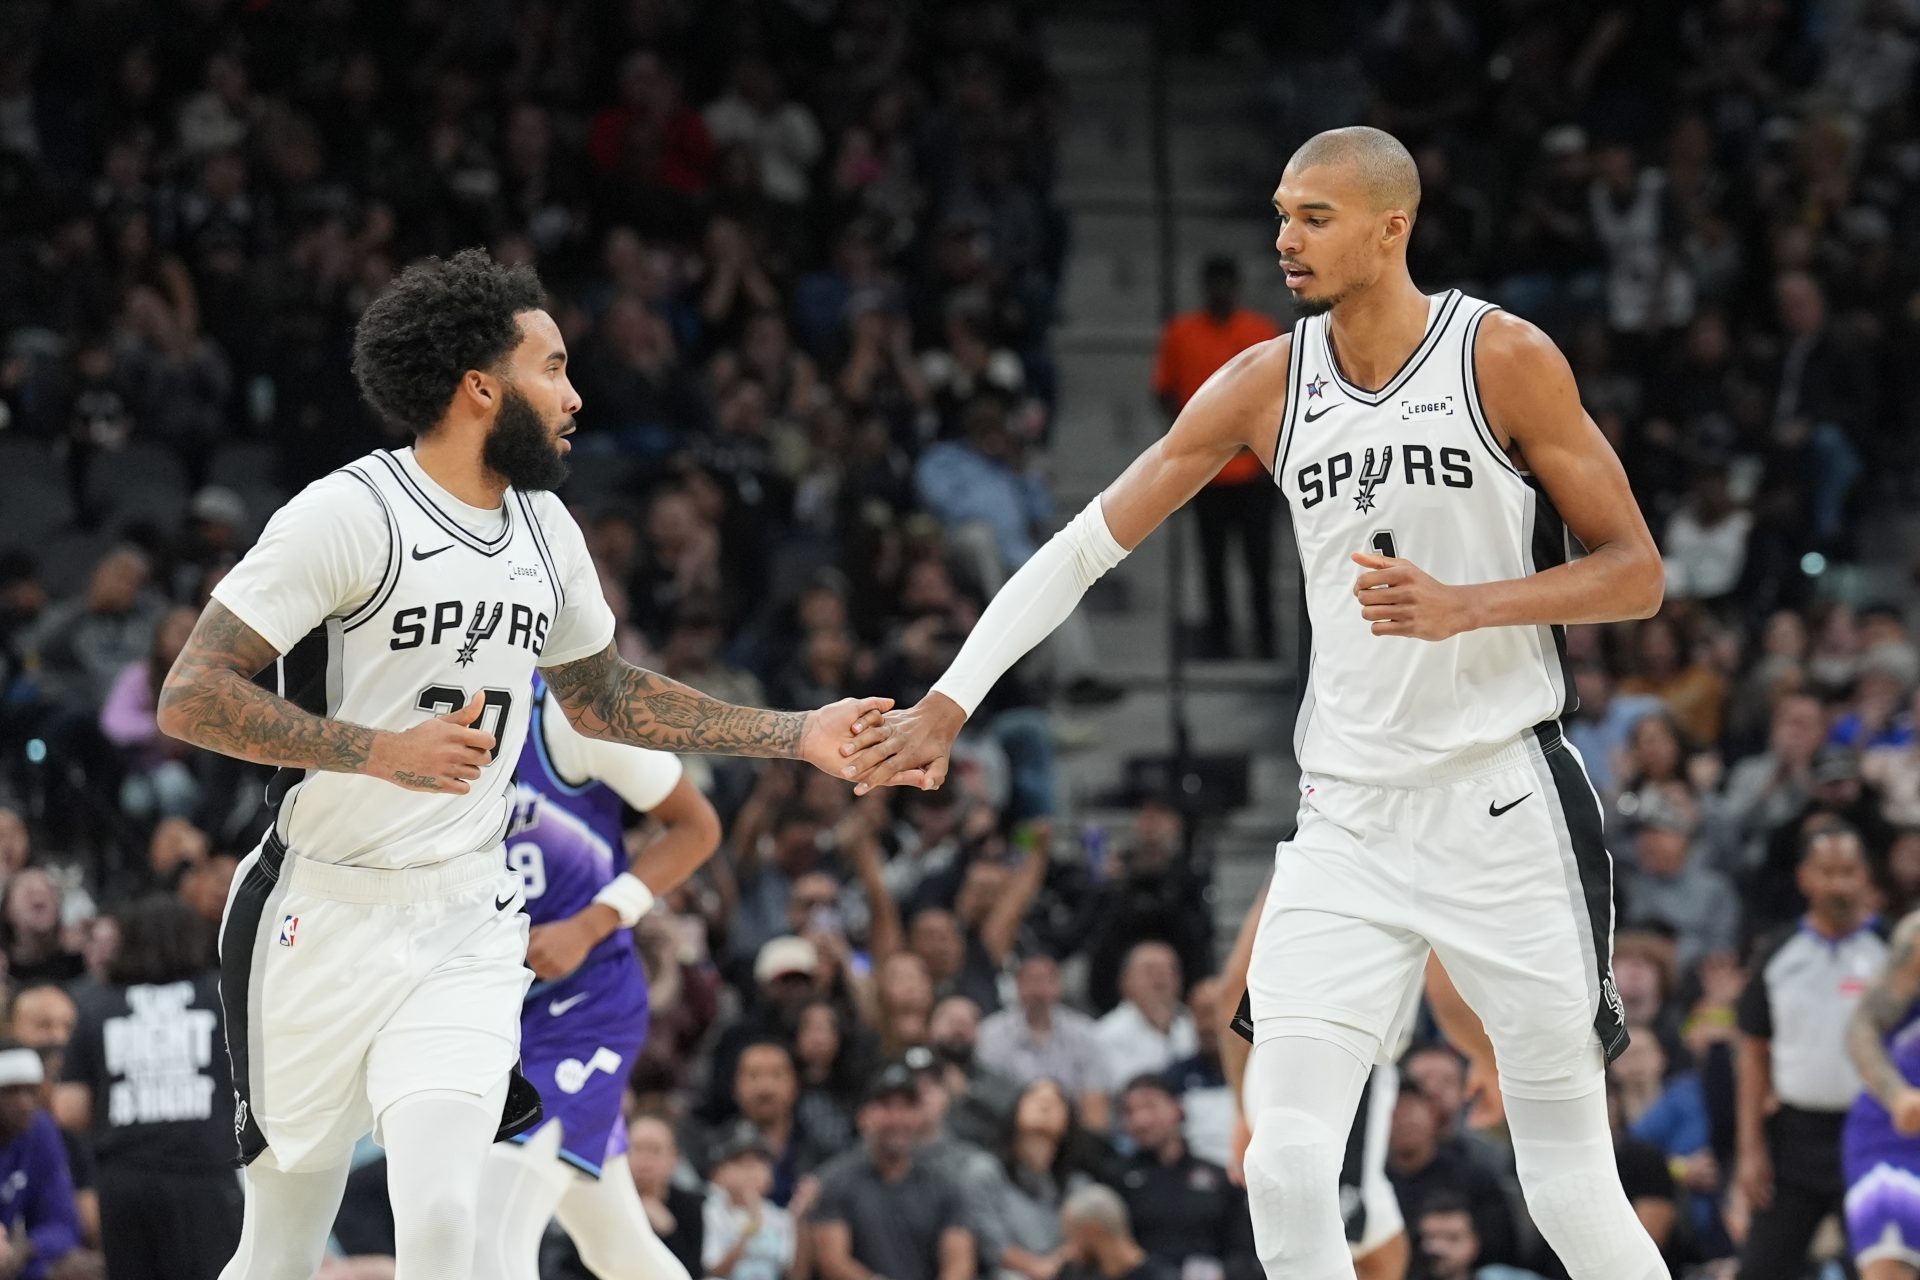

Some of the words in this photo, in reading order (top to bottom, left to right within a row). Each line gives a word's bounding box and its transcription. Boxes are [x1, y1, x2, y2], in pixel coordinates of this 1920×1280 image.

[1408, 402, 1446, 414] LEDGER
[1298, 444, 1473, 515] SPURS
[513, 566, 538, 577] LEDGER
[389, 600, 549, 669] SPURS
